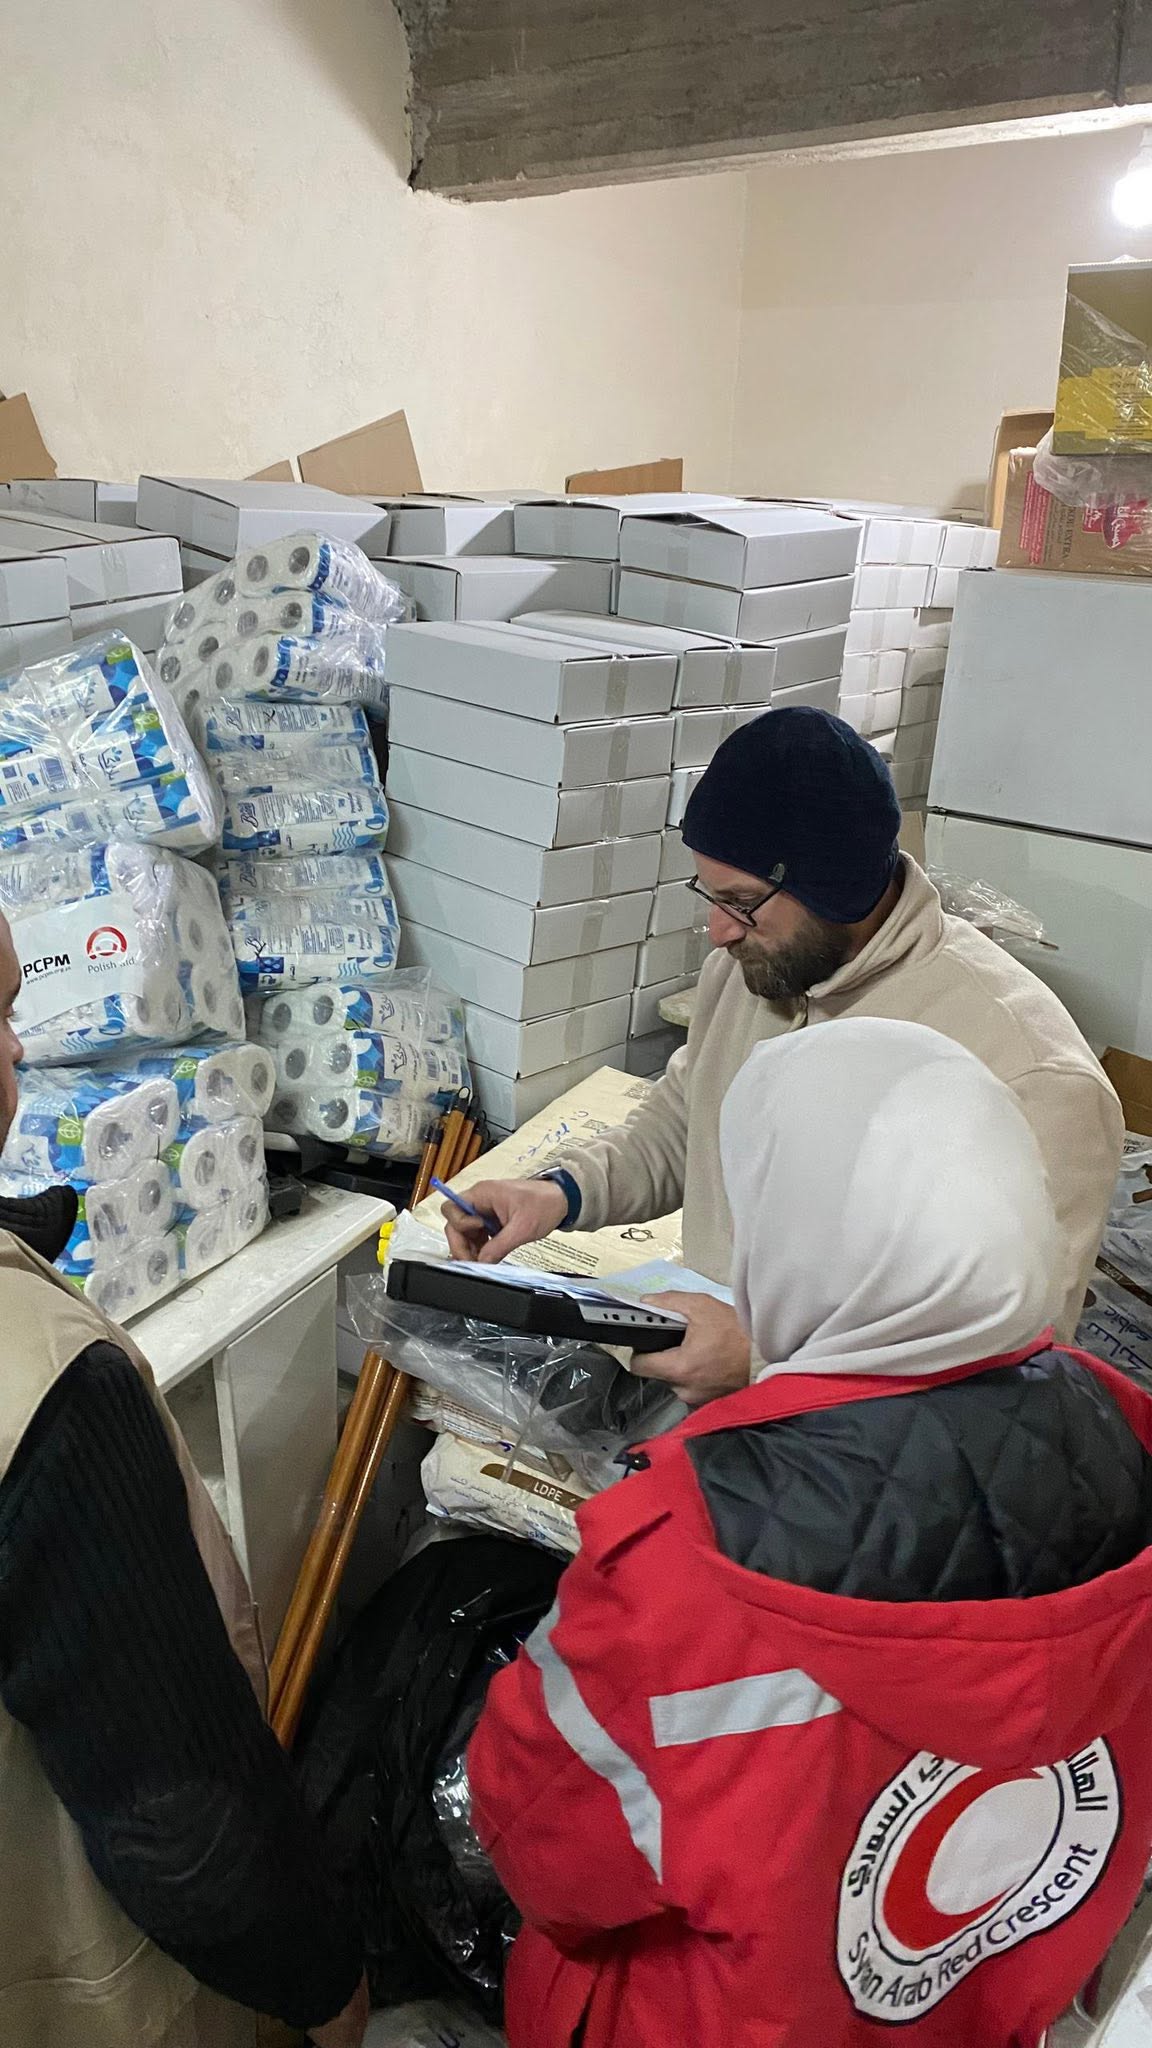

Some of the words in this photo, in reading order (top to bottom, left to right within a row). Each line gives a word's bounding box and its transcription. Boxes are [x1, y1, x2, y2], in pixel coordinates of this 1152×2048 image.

[23, 954, 71, 978] PCPM
[87, 960, 117, 974] Polish
[1101, 1262, 1124, 1281] LDPE
[1103, 1304, 1152, 1341] sabic
[533, 1481, 563, 1501] LDPE
[847, 1780, 917, 1898] السوري
[880, 1971, 933, 2007] Arab
[937, 1934, 982, 1989] Red
[985, 1842, 1099, 1946] Crescent
